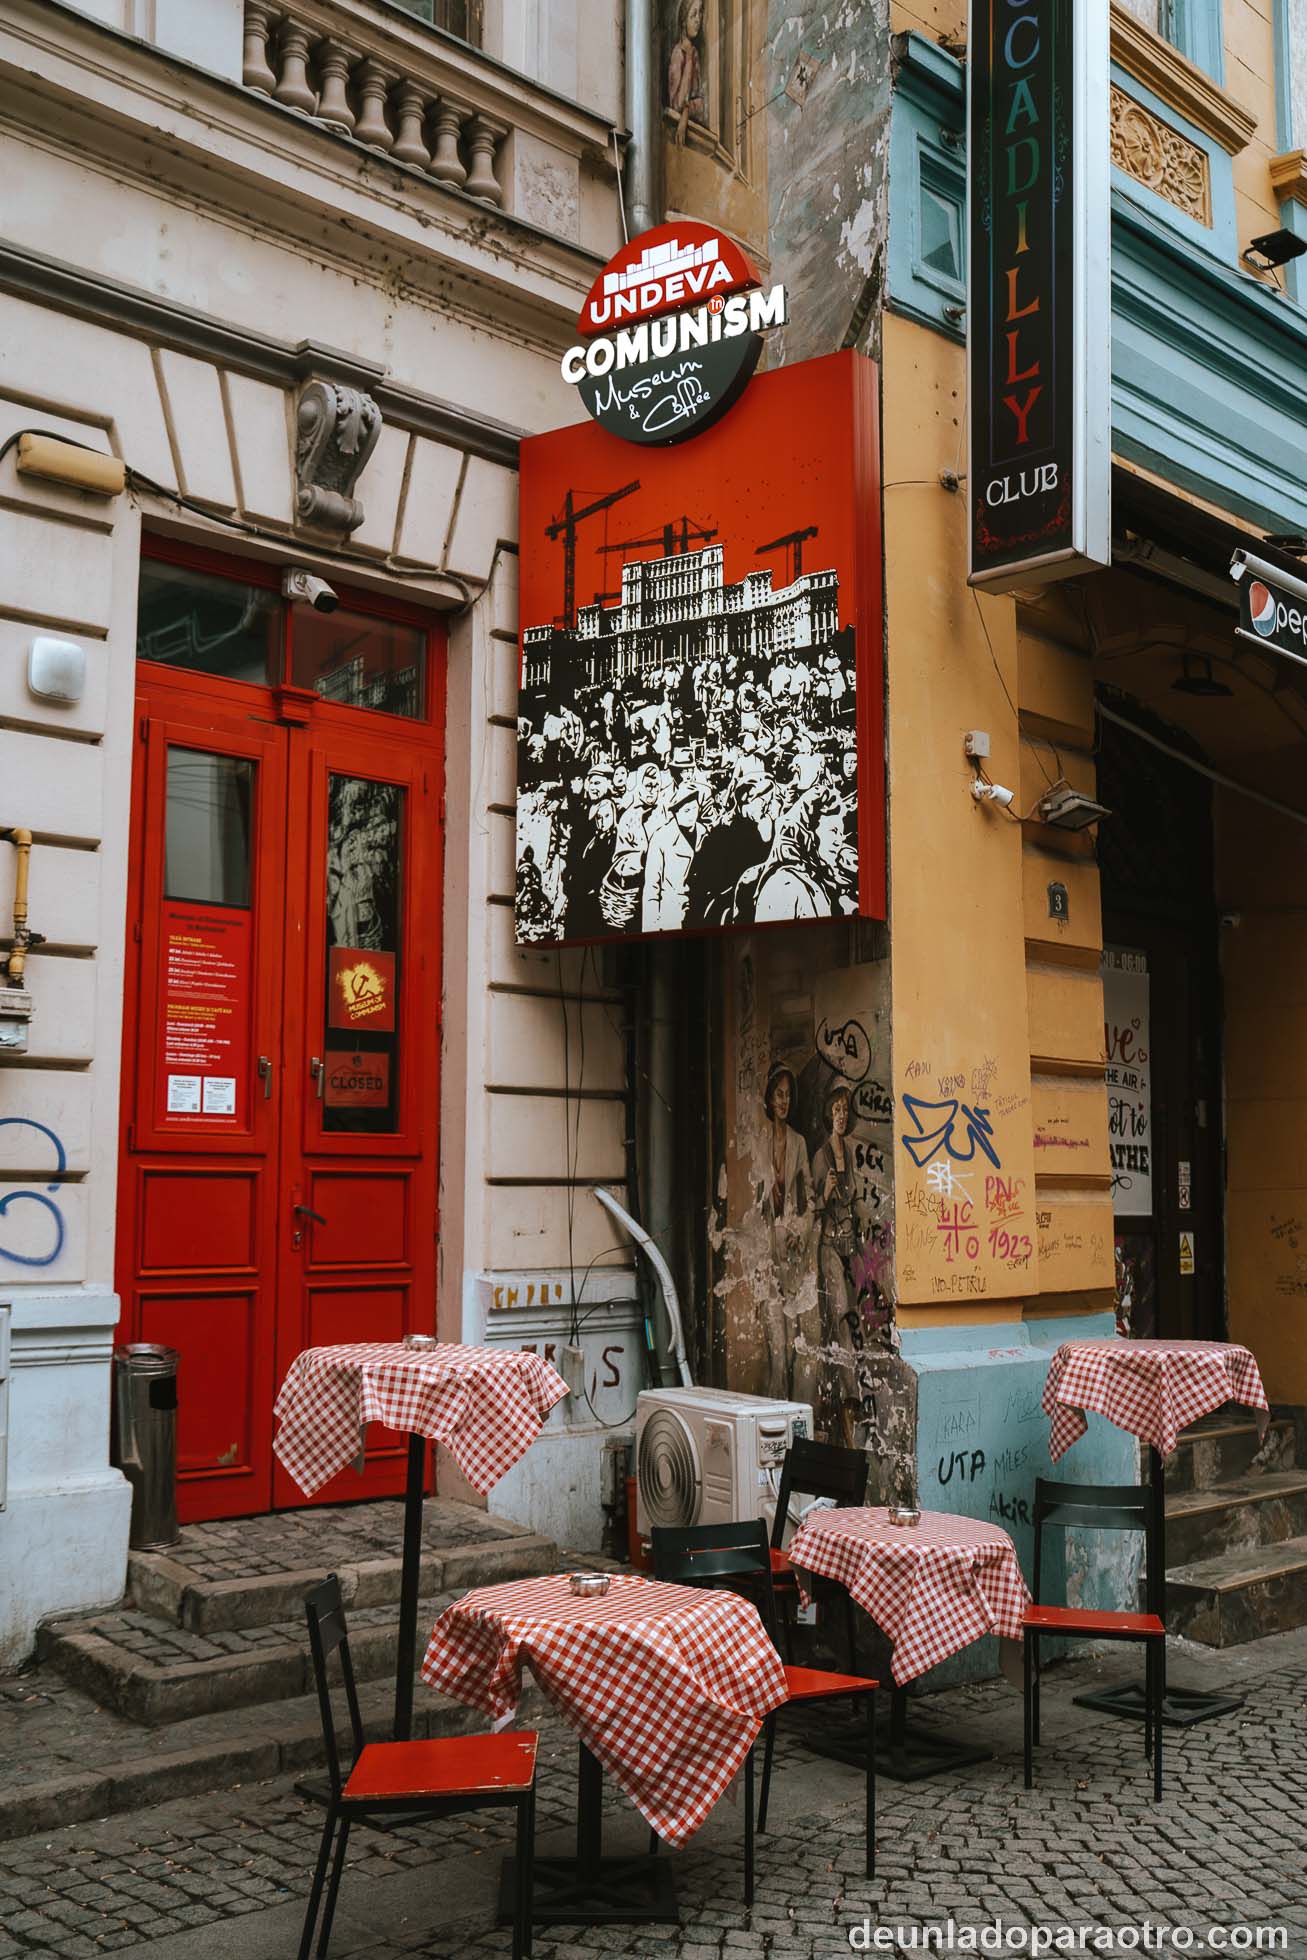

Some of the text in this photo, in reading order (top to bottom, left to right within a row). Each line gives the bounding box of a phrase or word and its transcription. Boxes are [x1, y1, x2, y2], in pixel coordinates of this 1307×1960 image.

[1003, 0, 1043, 445] CADILLY
[590, 260, 734, 324] UNDEVA
[595, 361, 703, 416] Museum
[630, 377, 711, 432] & Coffee
[986, 462, 1058, 507] CLUB
[331, 1077, 383, 1090] CLOSED
[1122, 1072, 1137, 1089] AIR
[1130, 1107, 1147, 1137] to
[988, 1228, 1032, 1260] 1923
